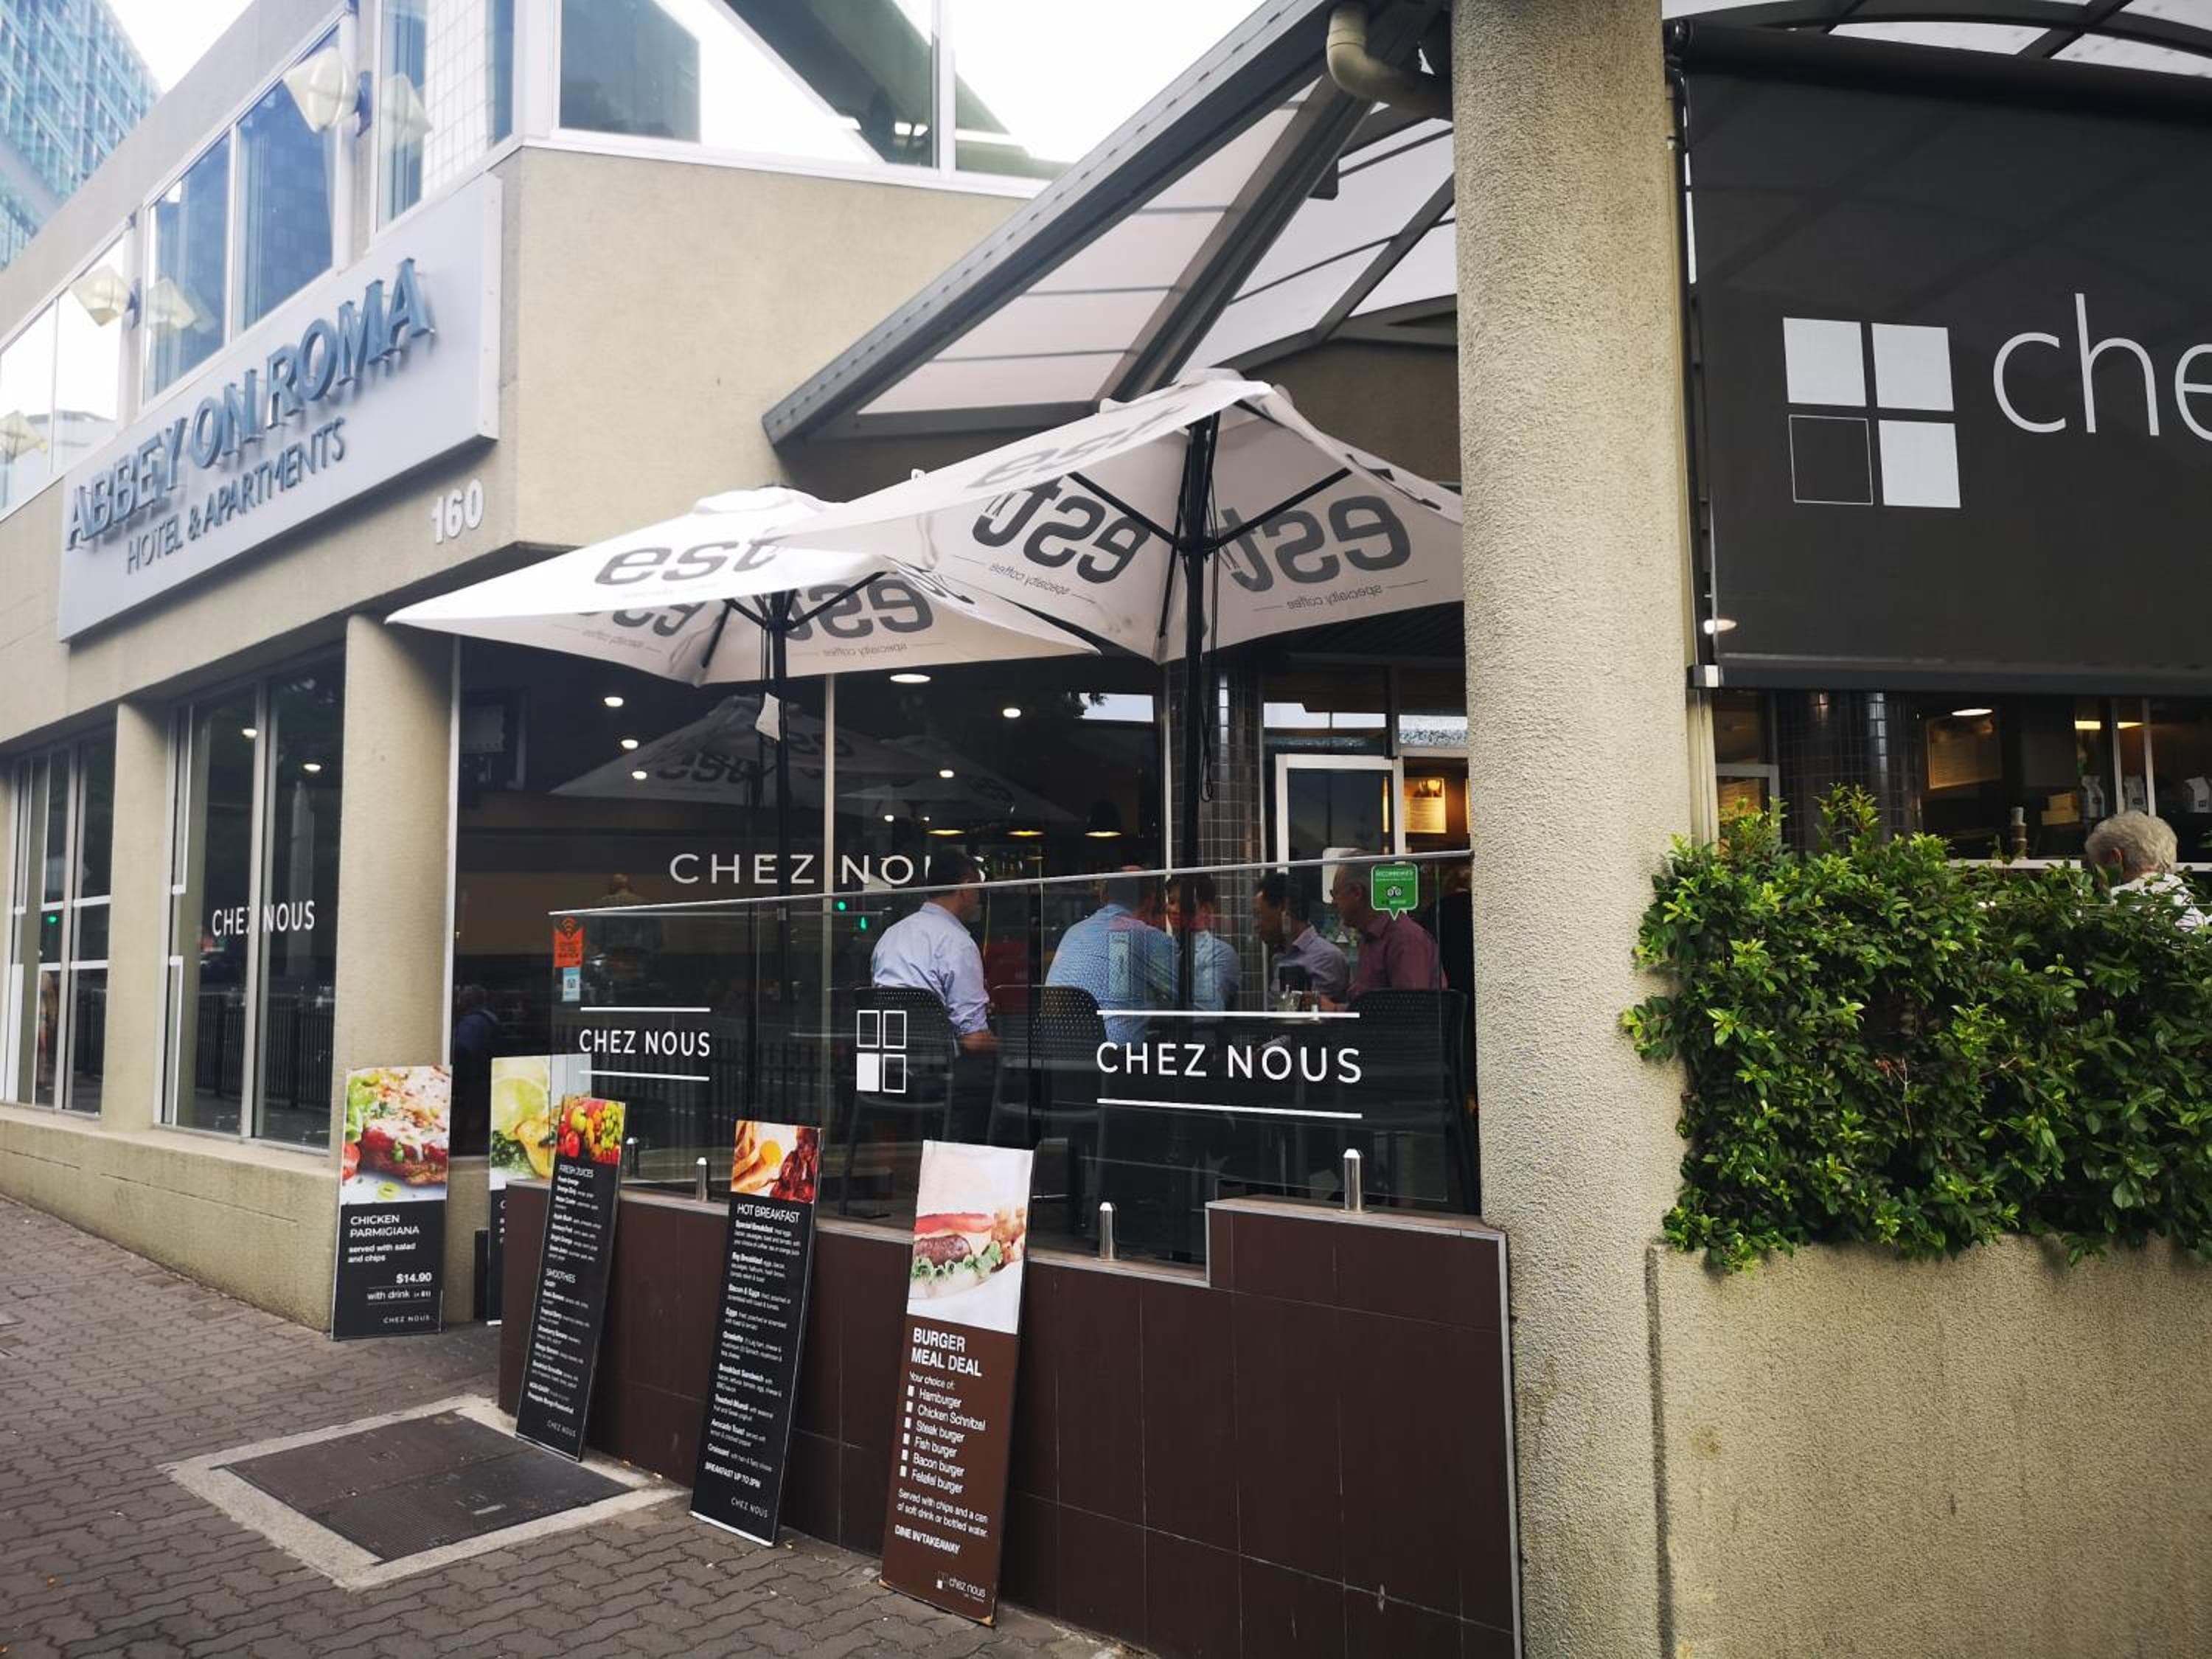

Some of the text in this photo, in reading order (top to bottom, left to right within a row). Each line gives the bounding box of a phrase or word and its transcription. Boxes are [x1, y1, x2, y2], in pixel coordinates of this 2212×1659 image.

[66, 257, 435, 551] ABBEY ON ROMA
[128, 417, 345, 574] HOTEL & APARTMENTS
[431, 479, 484, 544] 160
[594, 535, 779, 585] est
[669, 853, 815, 885] CHEZ
[262, 900, 315, 932] NOUS
[579, 1029, 711, 1057] CHEZ NOUS
[1096, 1042, 1363, 1084] CHEZ NOUS
[350, 1214, 400, 1225] CHICKEN
[737, 1203, 800, 1222] HOT BREAKFAST
[349, 1225, 420, 1238] PARMIGIANA
[348, 1254, 386, 1263] and chips
[349, 1242, 416, 1253] served with salad
[396, 1272, 432, 1284] $14.90
[366, 1292, 386, 1300] with
[388, 1290, 410, 1299] drink
[913, 1327, 965, 1352] BURGER
[911, 1347, 983, 1377] MEAL DEAL
[909, 1370, 924, 1383] Your
[924, 1374, 945, 1388] choice
[919, 1388, 962, 1409] Hamburger
[917, 1404, 986, 1431] Chicken Schnitzel
[916, 1420, 965, 1444] Steak burger
[914, 1436, 957, 1458] Fish burger
[913, 1452, 965, 1478] Bacon burger
[937, 1478, 964, 1495] burger
[731, 1497, 768, 1518] CHEZ NOUS
[898, 1488, 921, 1504] Served
[921, 1495, 936, 1507] with
[936, 1500, 954, 1514] chips
[953, 1505, 968, 1518] and
[974, 1514, 989, 1524] can
[905, 1504, 917, 1516] soft
[918, 1508, 934, 1521] drink
[934, 1515, 943, 1524] or
[943, 1516, 967, 1532] bottled
[894, 1524, 912, 1540] DINE
[967, 1584, 986, 1598] nous
